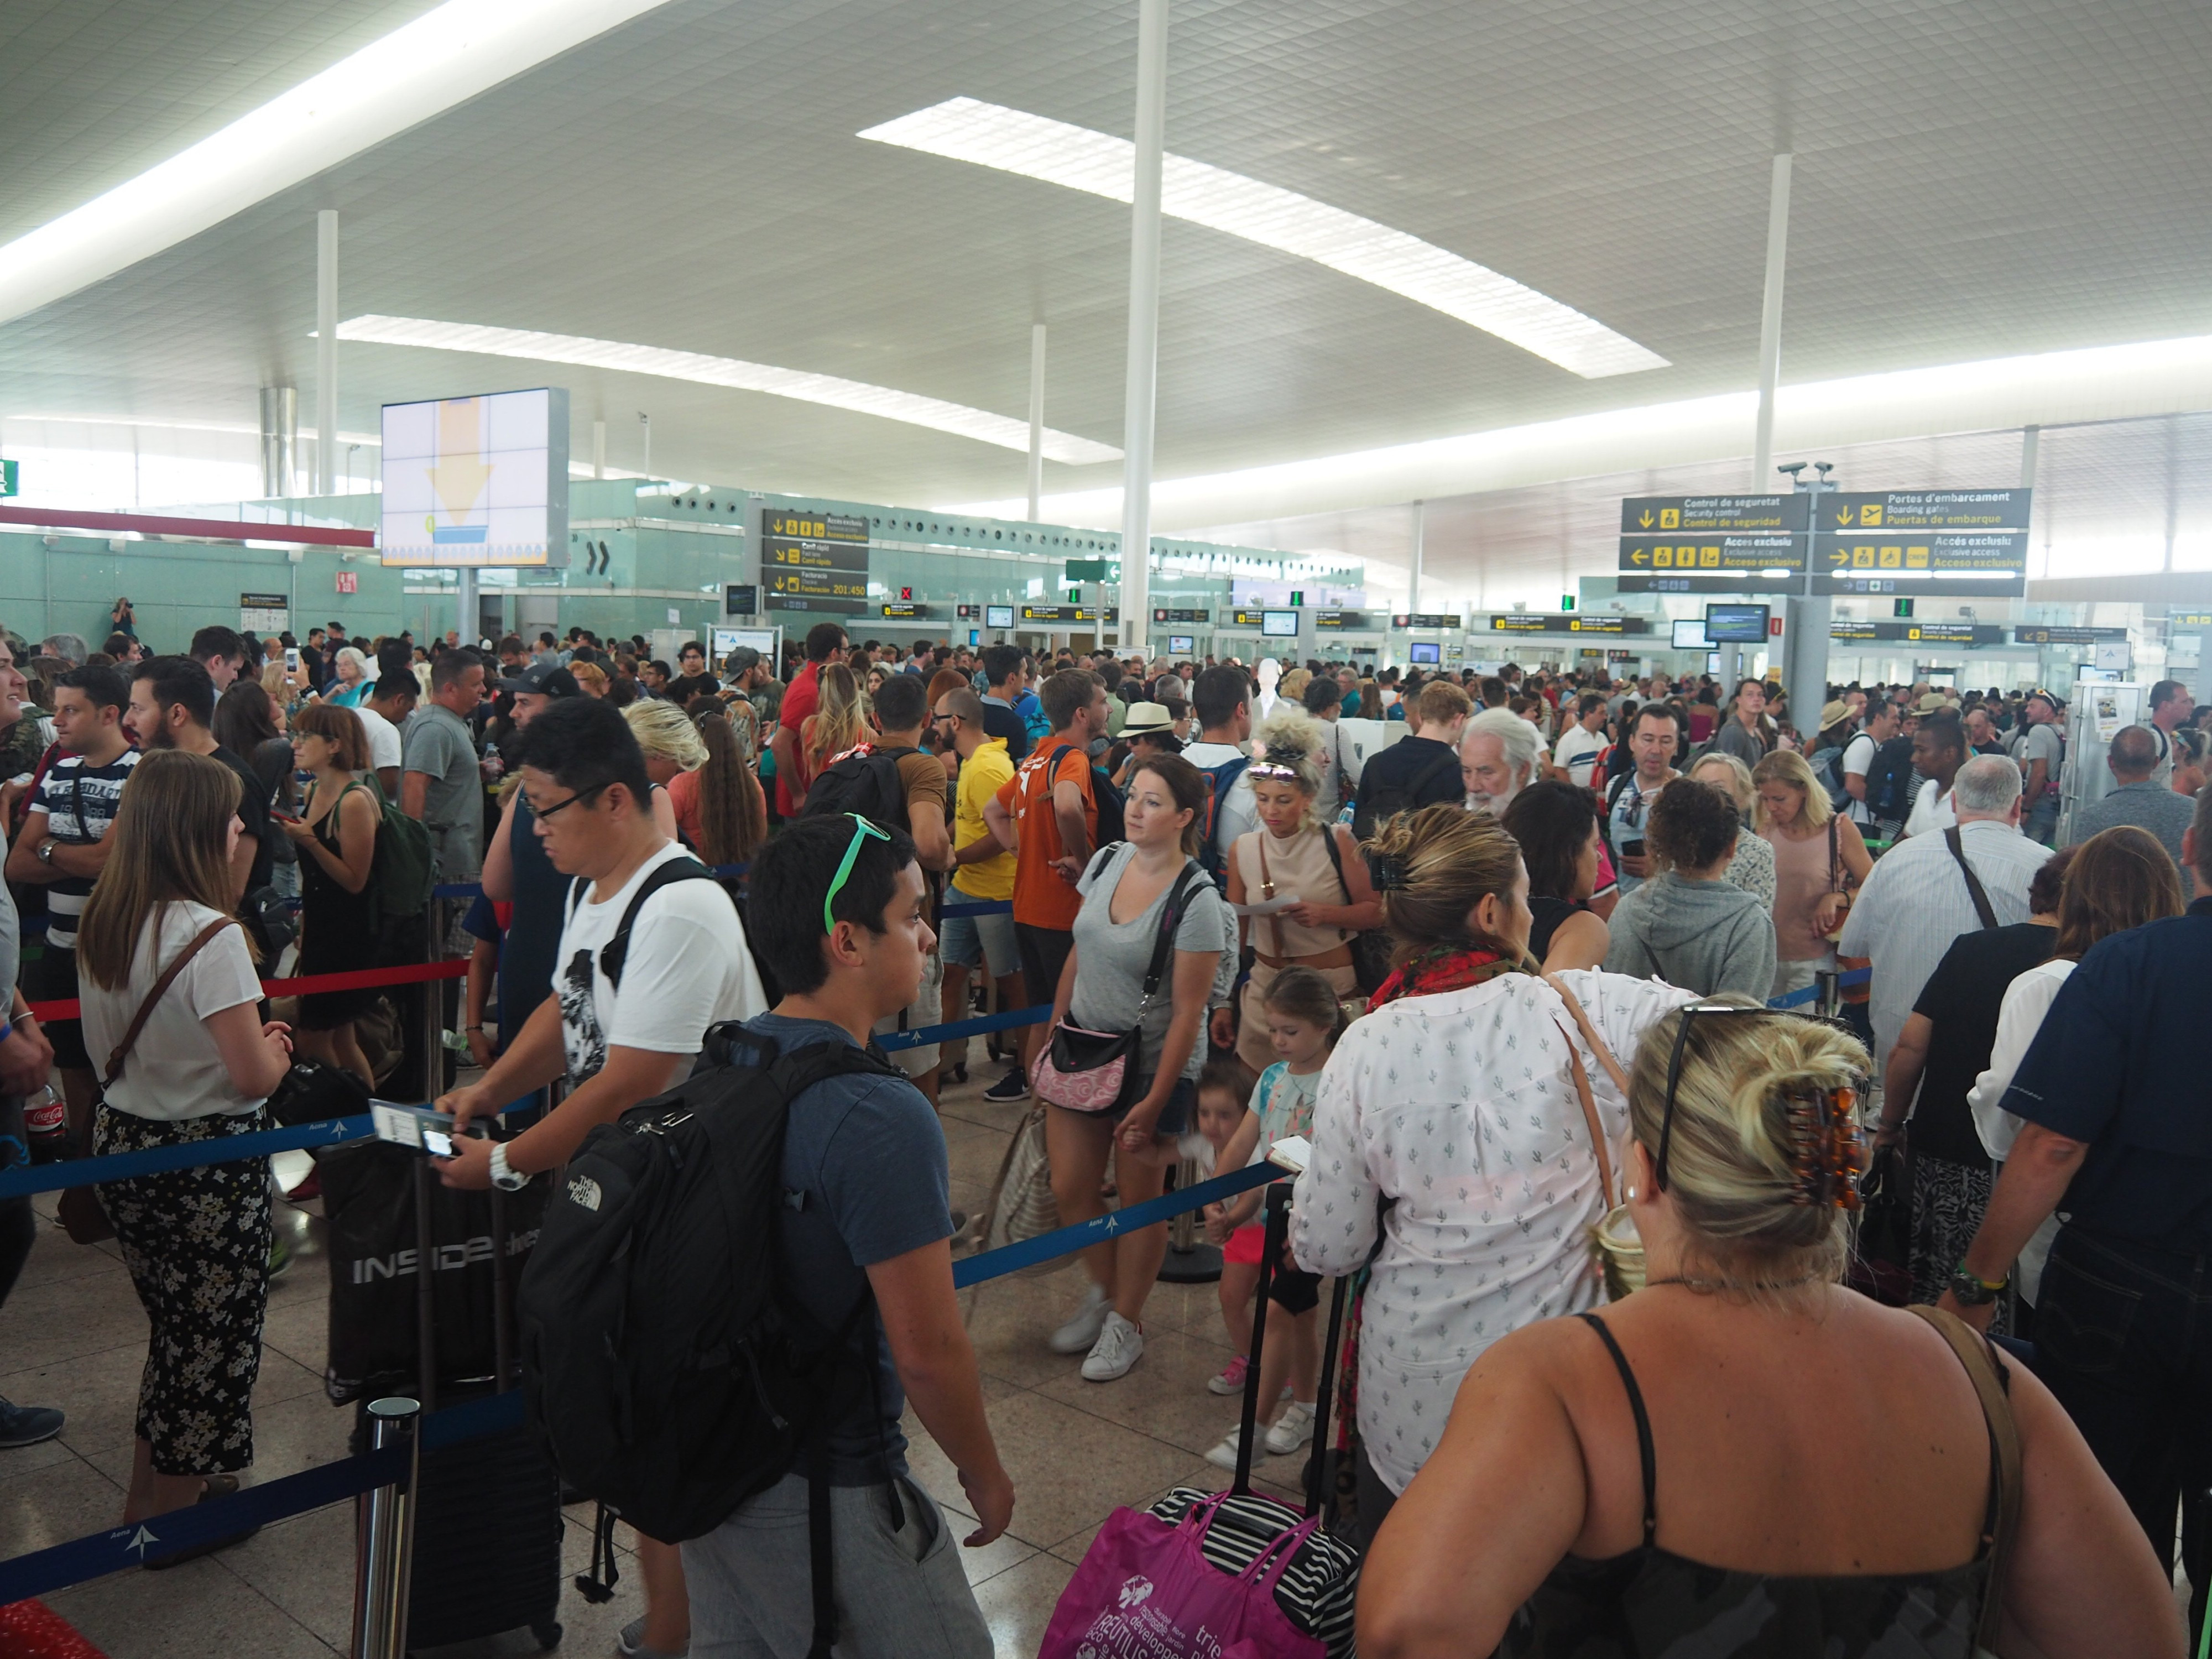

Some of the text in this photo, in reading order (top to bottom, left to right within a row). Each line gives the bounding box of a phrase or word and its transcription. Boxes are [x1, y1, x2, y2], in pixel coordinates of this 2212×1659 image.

[1684, 497, 1781, 508] Control de seguretat
[1888, 492, 2010, 504] Portes d'embarcament
[1684, 508, 1741, 518] Security control
[1887, 504, 1949, 515] Boarding gates
[1683, 517, 1781, 528] Control de seguridad
[1886, 514, 2002, 525] Puertas de embarque
[1753, 536, 1792, 546] exclusiu
[1968, 535, 2012, 546] exclusiu
[1971, 548, 2001, 556] access
[1723, 556, 1802, 567] Acceso exclusivo
[1933, 557, 2023, 567] Acceso exclusivo
[309, 1122, 328, 1131] Aena
[580, 1175, 593, 1190] THE
[567, 1180, 592, 1199] NORTH
[569, 1191, 591, 1207] FACE
[1088, 1218, 1103, 1228] Aena
[110, 1528, 131, 1540] Aena
[1095, 1614, 1149, 1659] REUTILIS
[1130, 1616, 1185, 1659] développe
[1165, 1635, 1184, 1651] jardin
